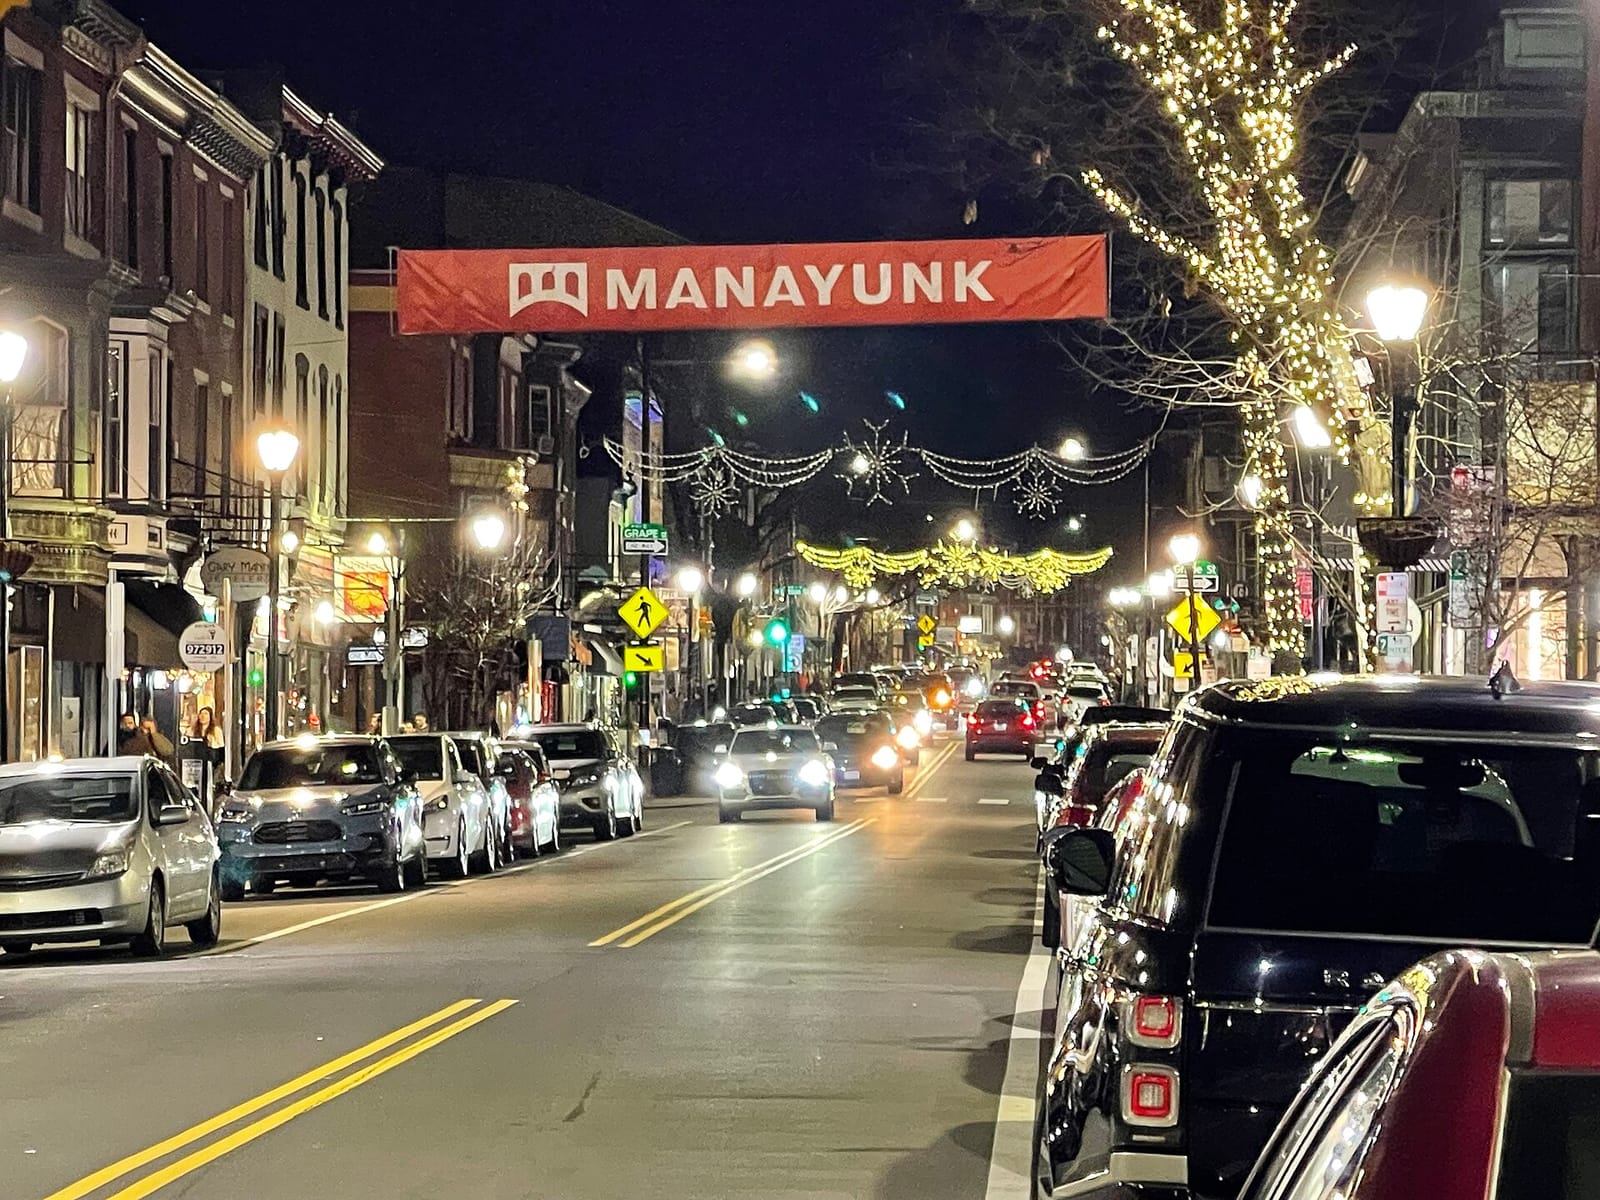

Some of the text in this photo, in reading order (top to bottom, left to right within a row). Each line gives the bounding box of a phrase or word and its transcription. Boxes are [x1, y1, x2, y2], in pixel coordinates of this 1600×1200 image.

[606, 260, 995, 311] MANAYUNK
[624, 529, 659, 538] GRAPE
[1174, 564, 1217, 575] Gre St
[187, 645, 223, 654] 972912
